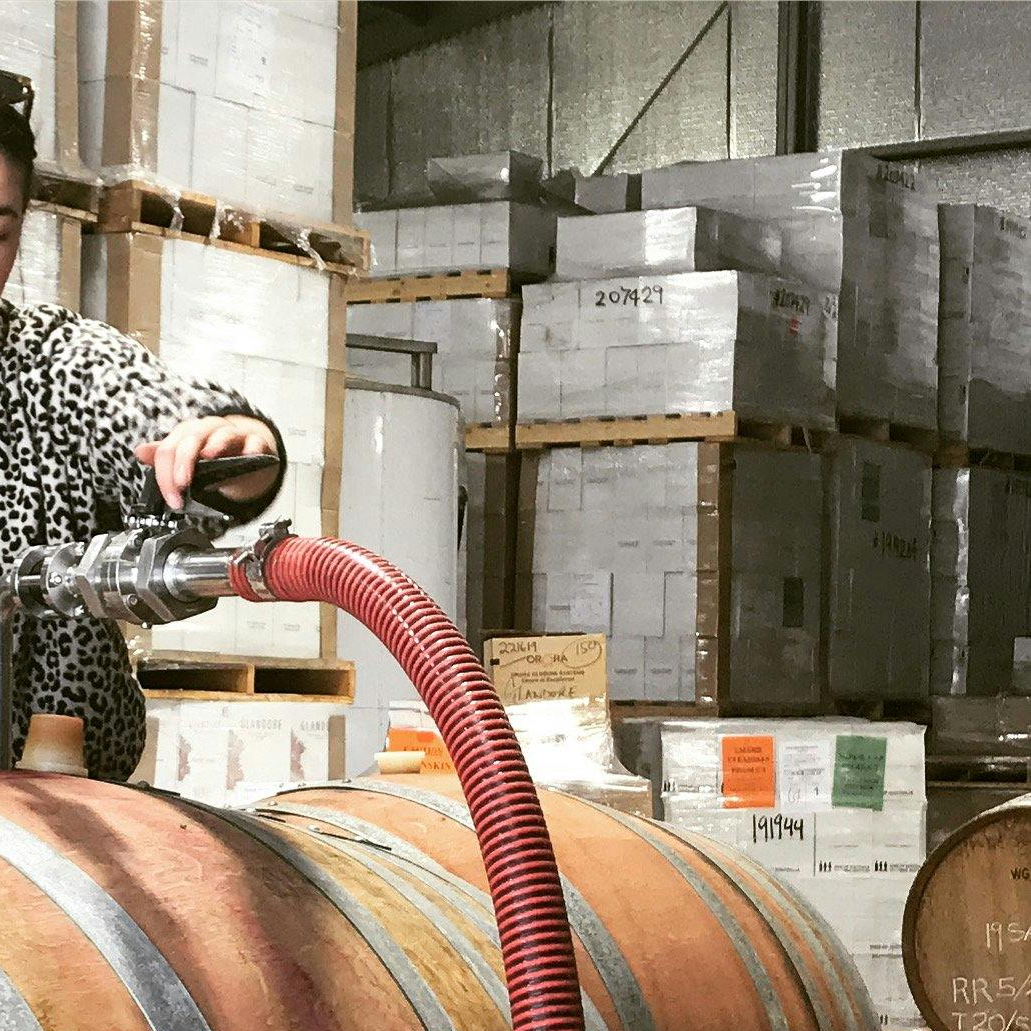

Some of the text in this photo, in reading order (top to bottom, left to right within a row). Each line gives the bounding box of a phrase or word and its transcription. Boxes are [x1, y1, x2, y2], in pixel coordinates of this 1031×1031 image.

[595, 286, 664, 307] 207429
[752, 812, 805, 844] 191944
[986, 921, 1003, 951] 19
[952, 977, 994, 1006] RR
